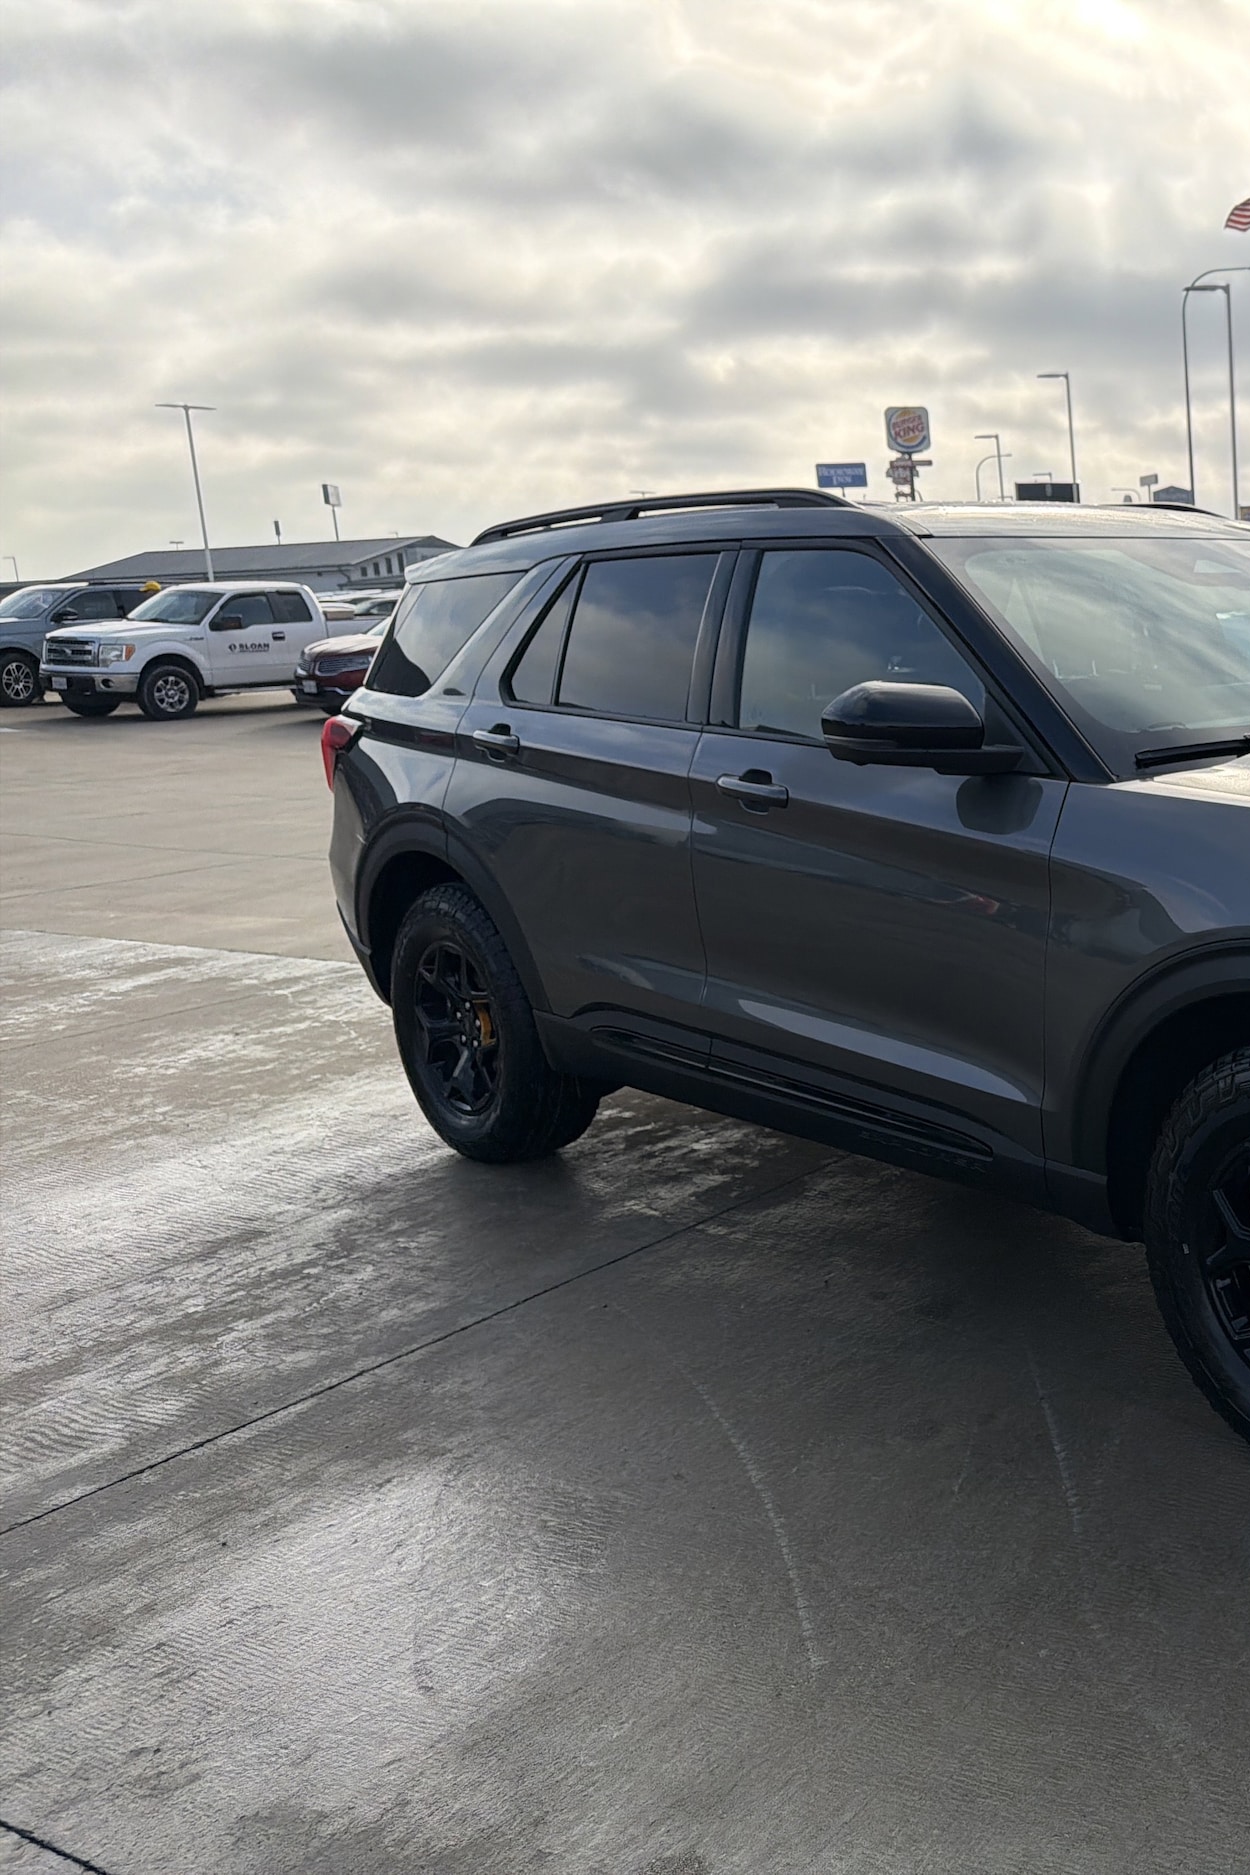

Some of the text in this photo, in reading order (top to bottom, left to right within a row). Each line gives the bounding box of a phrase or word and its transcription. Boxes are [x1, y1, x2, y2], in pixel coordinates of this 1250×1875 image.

[892, 415, 923, 430] BURGER
[894, 423, 925, 439] KING
[238, 642, 270, 650] SLOAN
